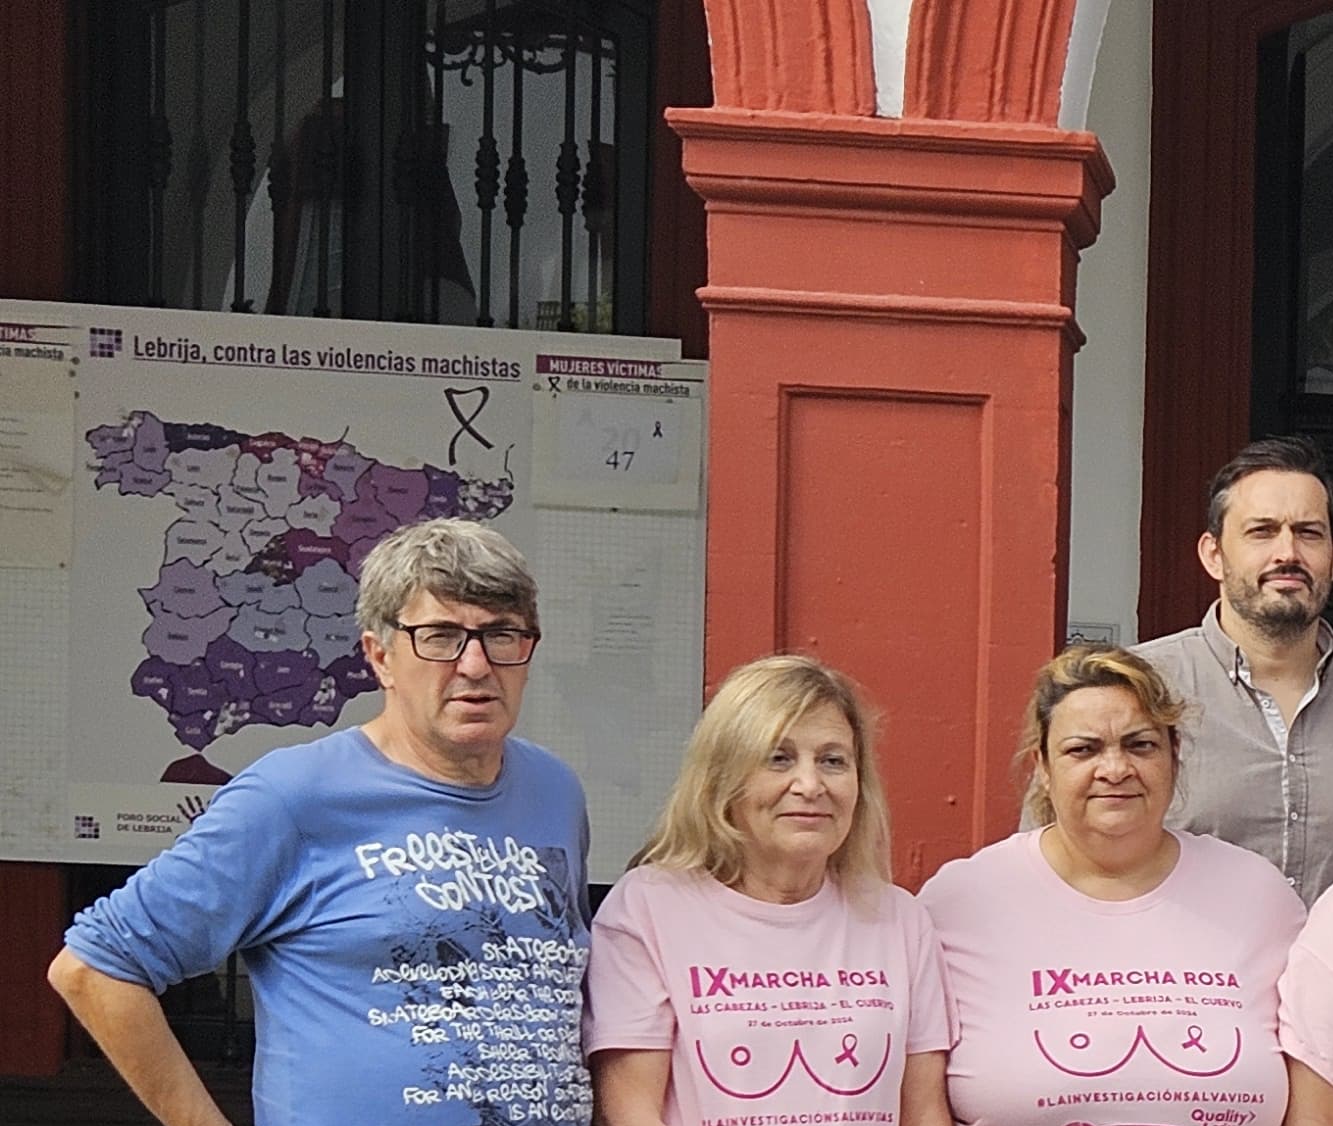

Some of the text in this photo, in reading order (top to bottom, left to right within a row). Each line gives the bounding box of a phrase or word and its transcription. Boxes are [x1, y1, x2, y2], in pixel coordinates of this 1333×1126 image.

[133, 335, 521, 378] Lebrija, contra las violencias machistas
[550, 359, 604, 374] MUJERES
[567, 378, 690, 397] de la violencia machista
[606, 450, 635, 471] 47
[117, 813, 182, 824] FORO SOCIAL
[117, 824, 173, 833] DE LEBRIJA
[689, 966, 889, 998] IX MARCHA ROSA
[1032, 968, 1241, 997] IX MARCHA ROSA
[690, 1003, 710, 1014] LAS
[714, 1002, 768, 1013] CABEZAS
[781, 1000, 827, 1012] LEBRIJA
[839, 999, 853, 1009] EL
[1029, 1001, 1051, 1011] LAS
[1054, 997, 1109, 1008] CABEZAS
[1123, 995, 1172, 1004] LEBRIJA
[1184, 996, 1199, 1005] EL
[1201, 997, 1243, 1009] CUERVO
[411, 1025, 450, 1044] FOR
[403, 1087, 442, 1105] FOR
[1191, 1109, 1248, 1126] Quality
